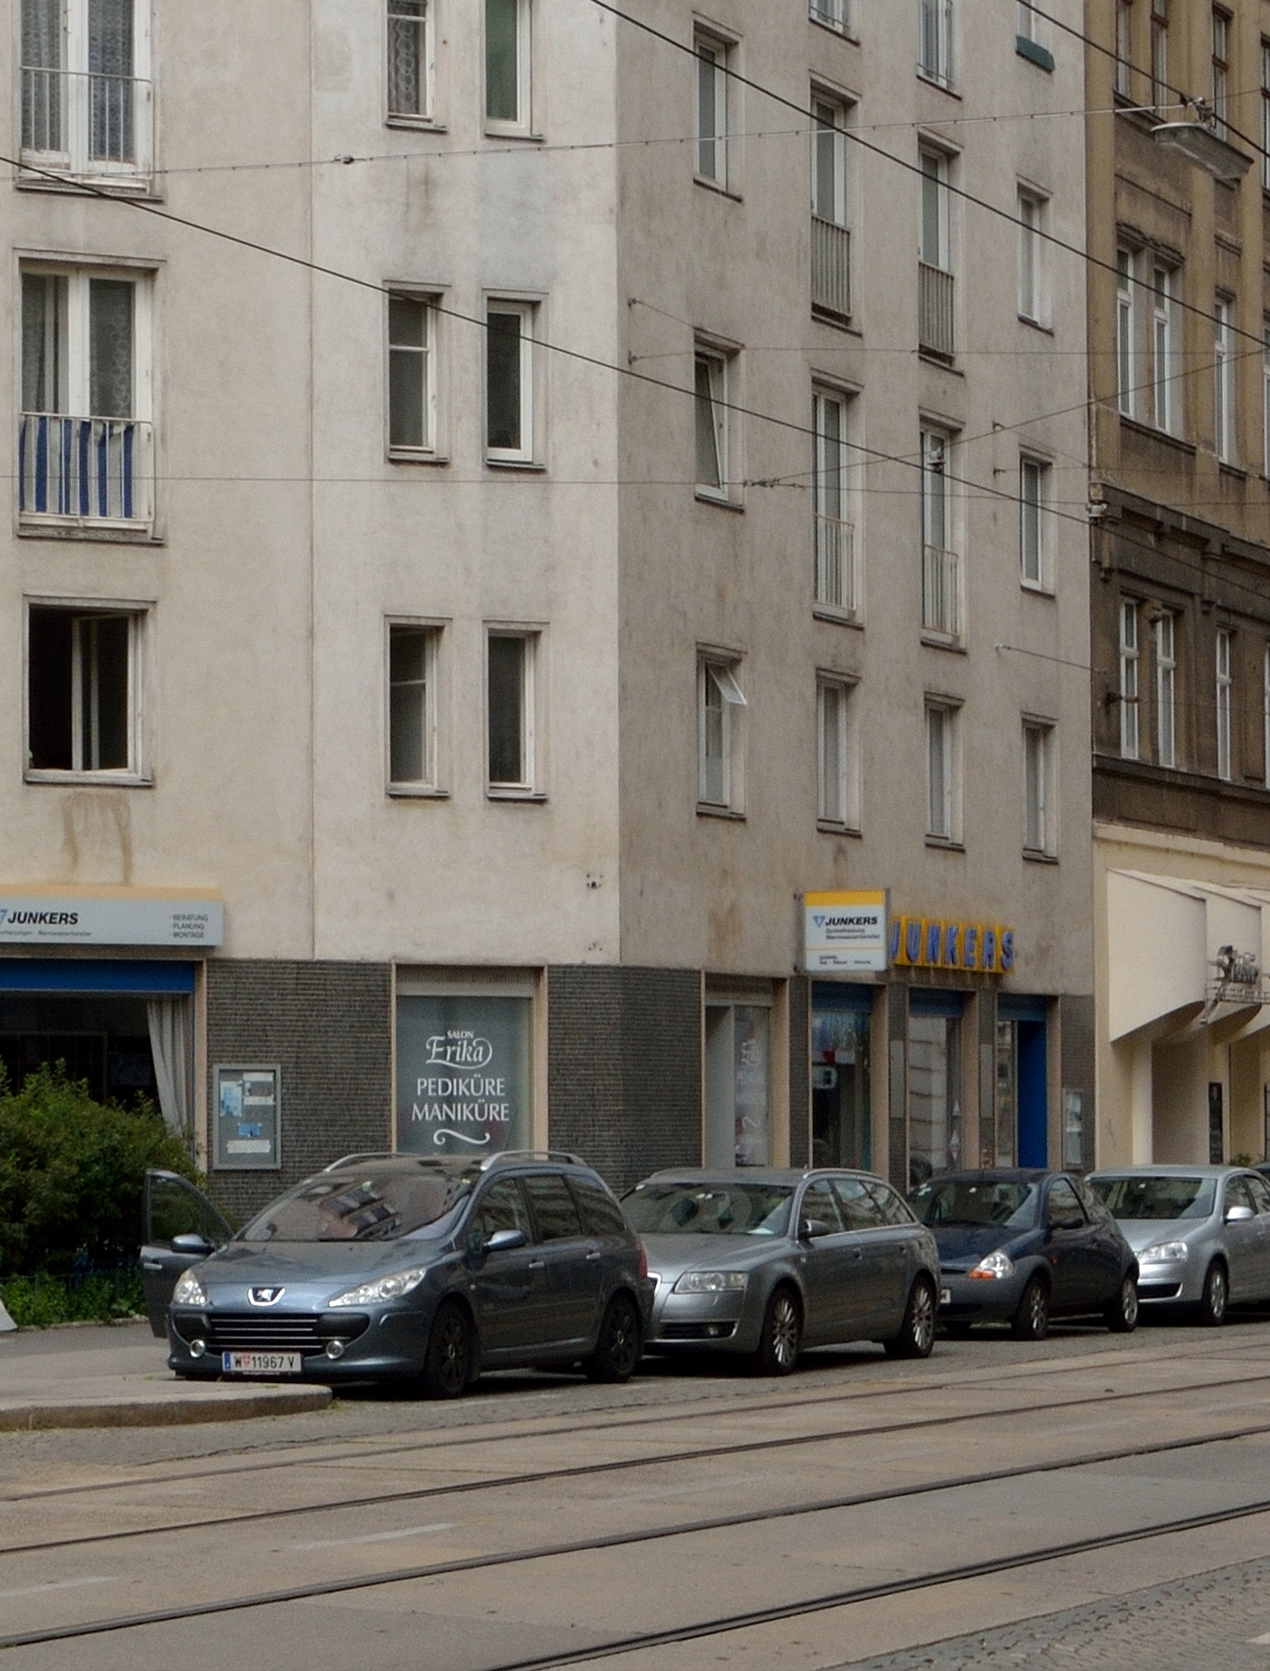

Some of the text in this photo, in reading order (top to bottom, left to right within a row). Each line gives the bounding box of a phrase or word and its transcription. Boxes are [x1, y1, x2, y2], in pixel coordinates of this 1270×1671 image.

[7, 911, 79, 925] JUNKERS
[825, 916, 878, 926] JUNKERS
[891, 920, 1014, 971] JUNKERS
[447, 1030, 475, 1039] SALON
[426, 1036, 493, 1069] Erika
[417, 1073, 506, 1096] PEDIKÜRE
[411, 1098, 510, 1121] MANIKÜRE
